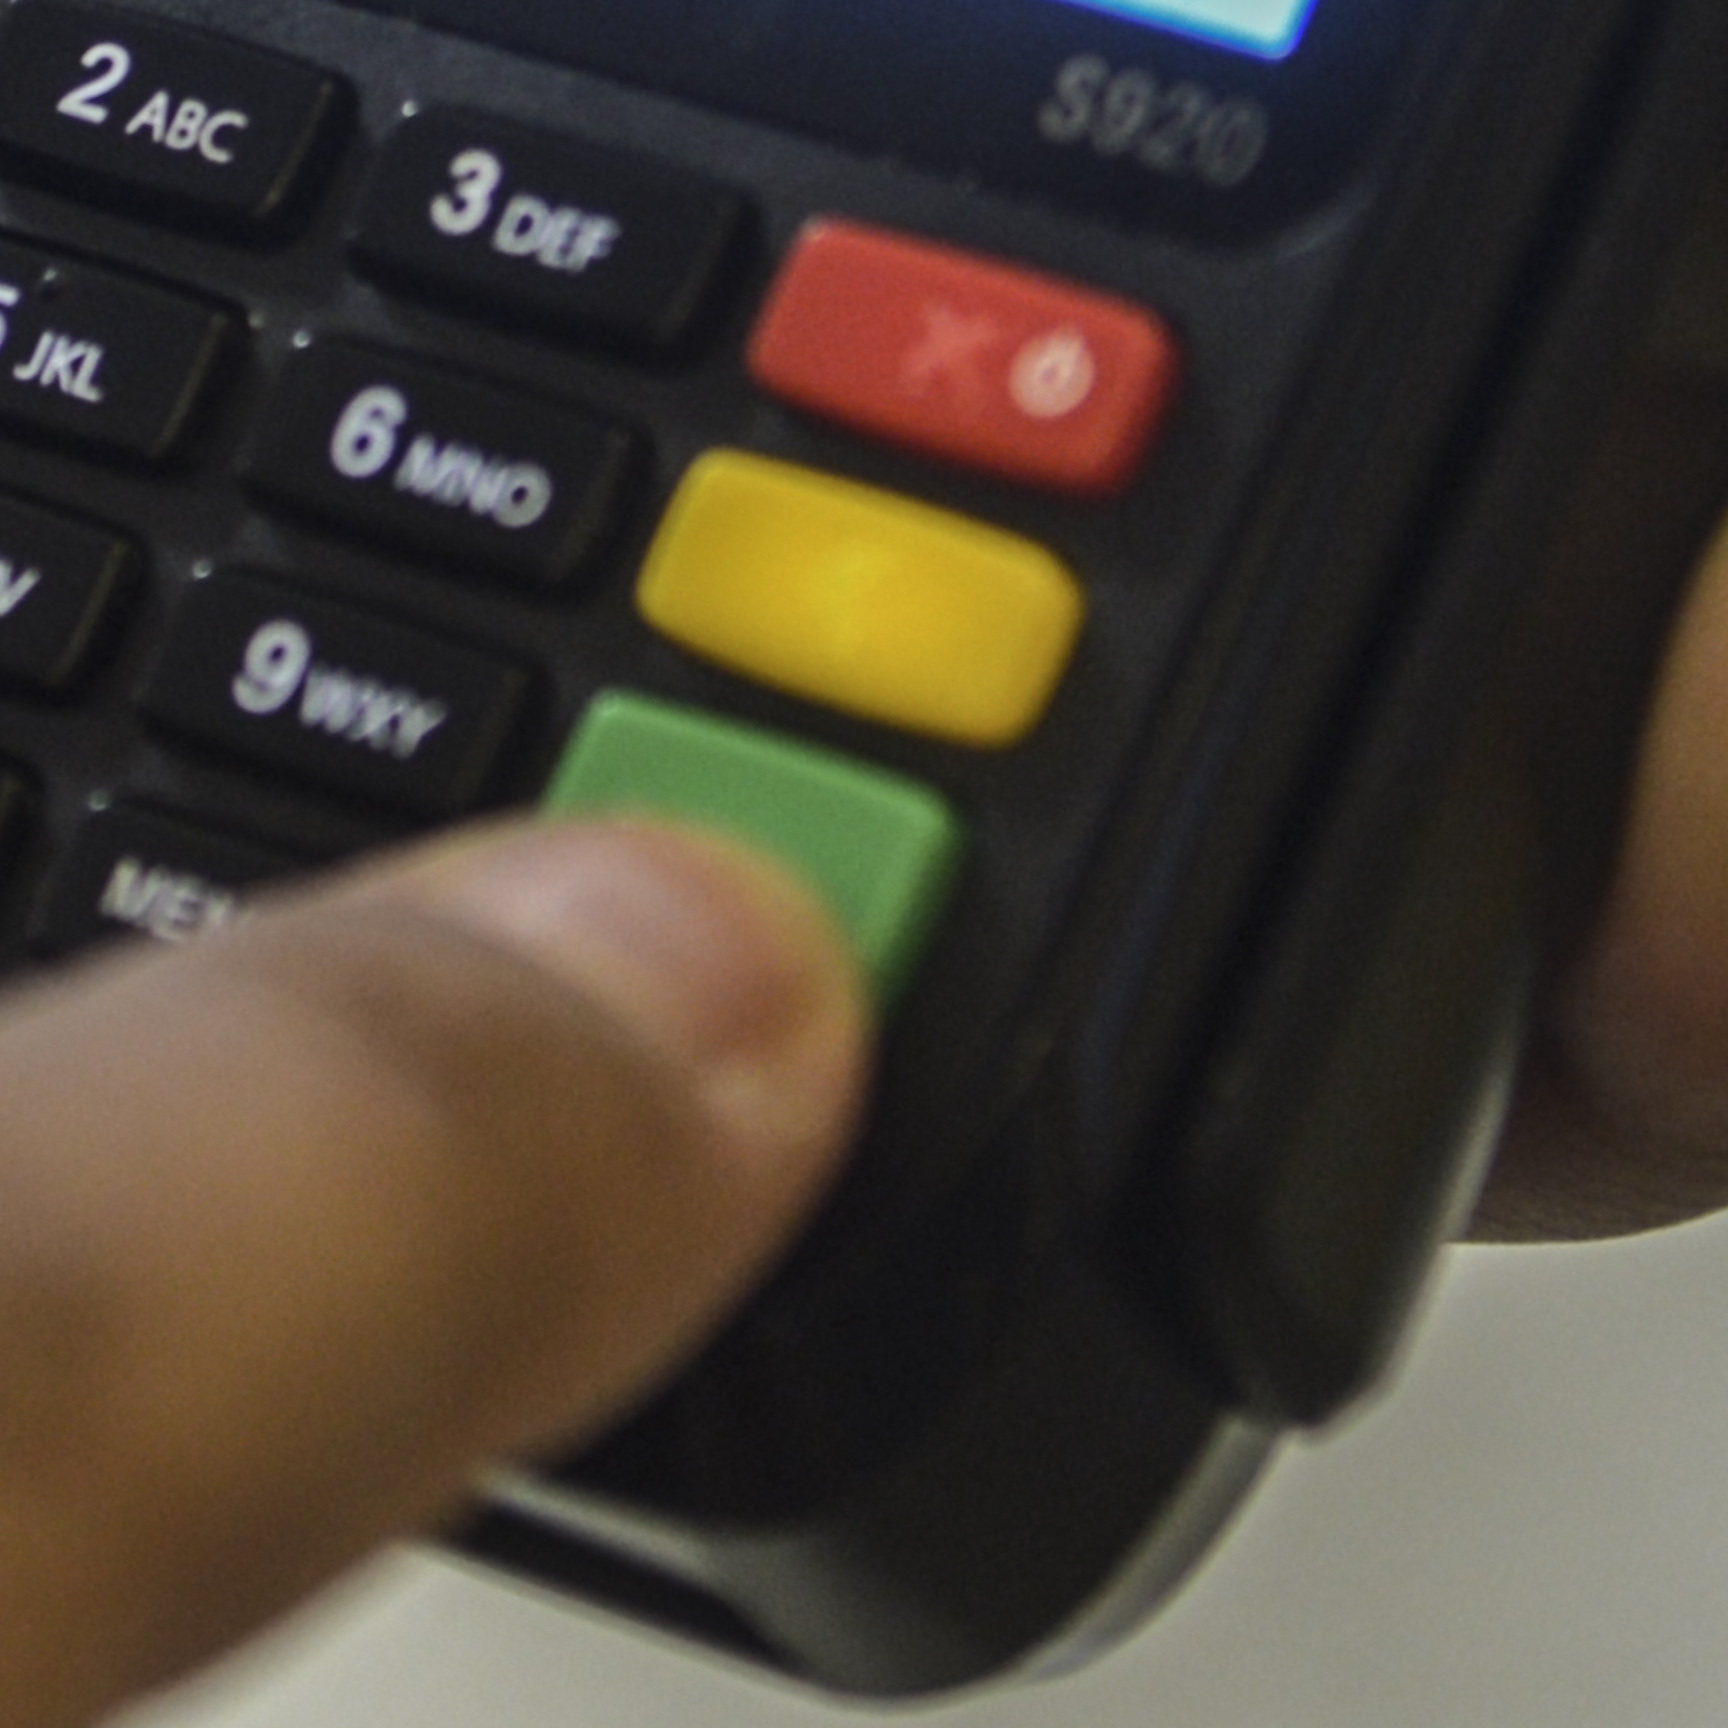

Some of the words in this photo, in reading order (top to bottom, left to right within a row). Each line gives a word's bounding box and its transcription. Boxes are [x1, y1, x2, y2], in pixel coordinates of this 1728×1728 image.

[58, 43, 131, 123] 2
[125, 100, 248, 164] ABC
[1038, 53, 1268, 188] S920
[429, 149, 502, 235] 3
[492, 195, 620, 271] DEF
[13, 331, 105, 403] JKL
[330, 385, 408, 477] 6
[393, 435, 554, 528] MNO
[232, 618, 312, 715] 9
[299, 666, 448, 759] WXY
